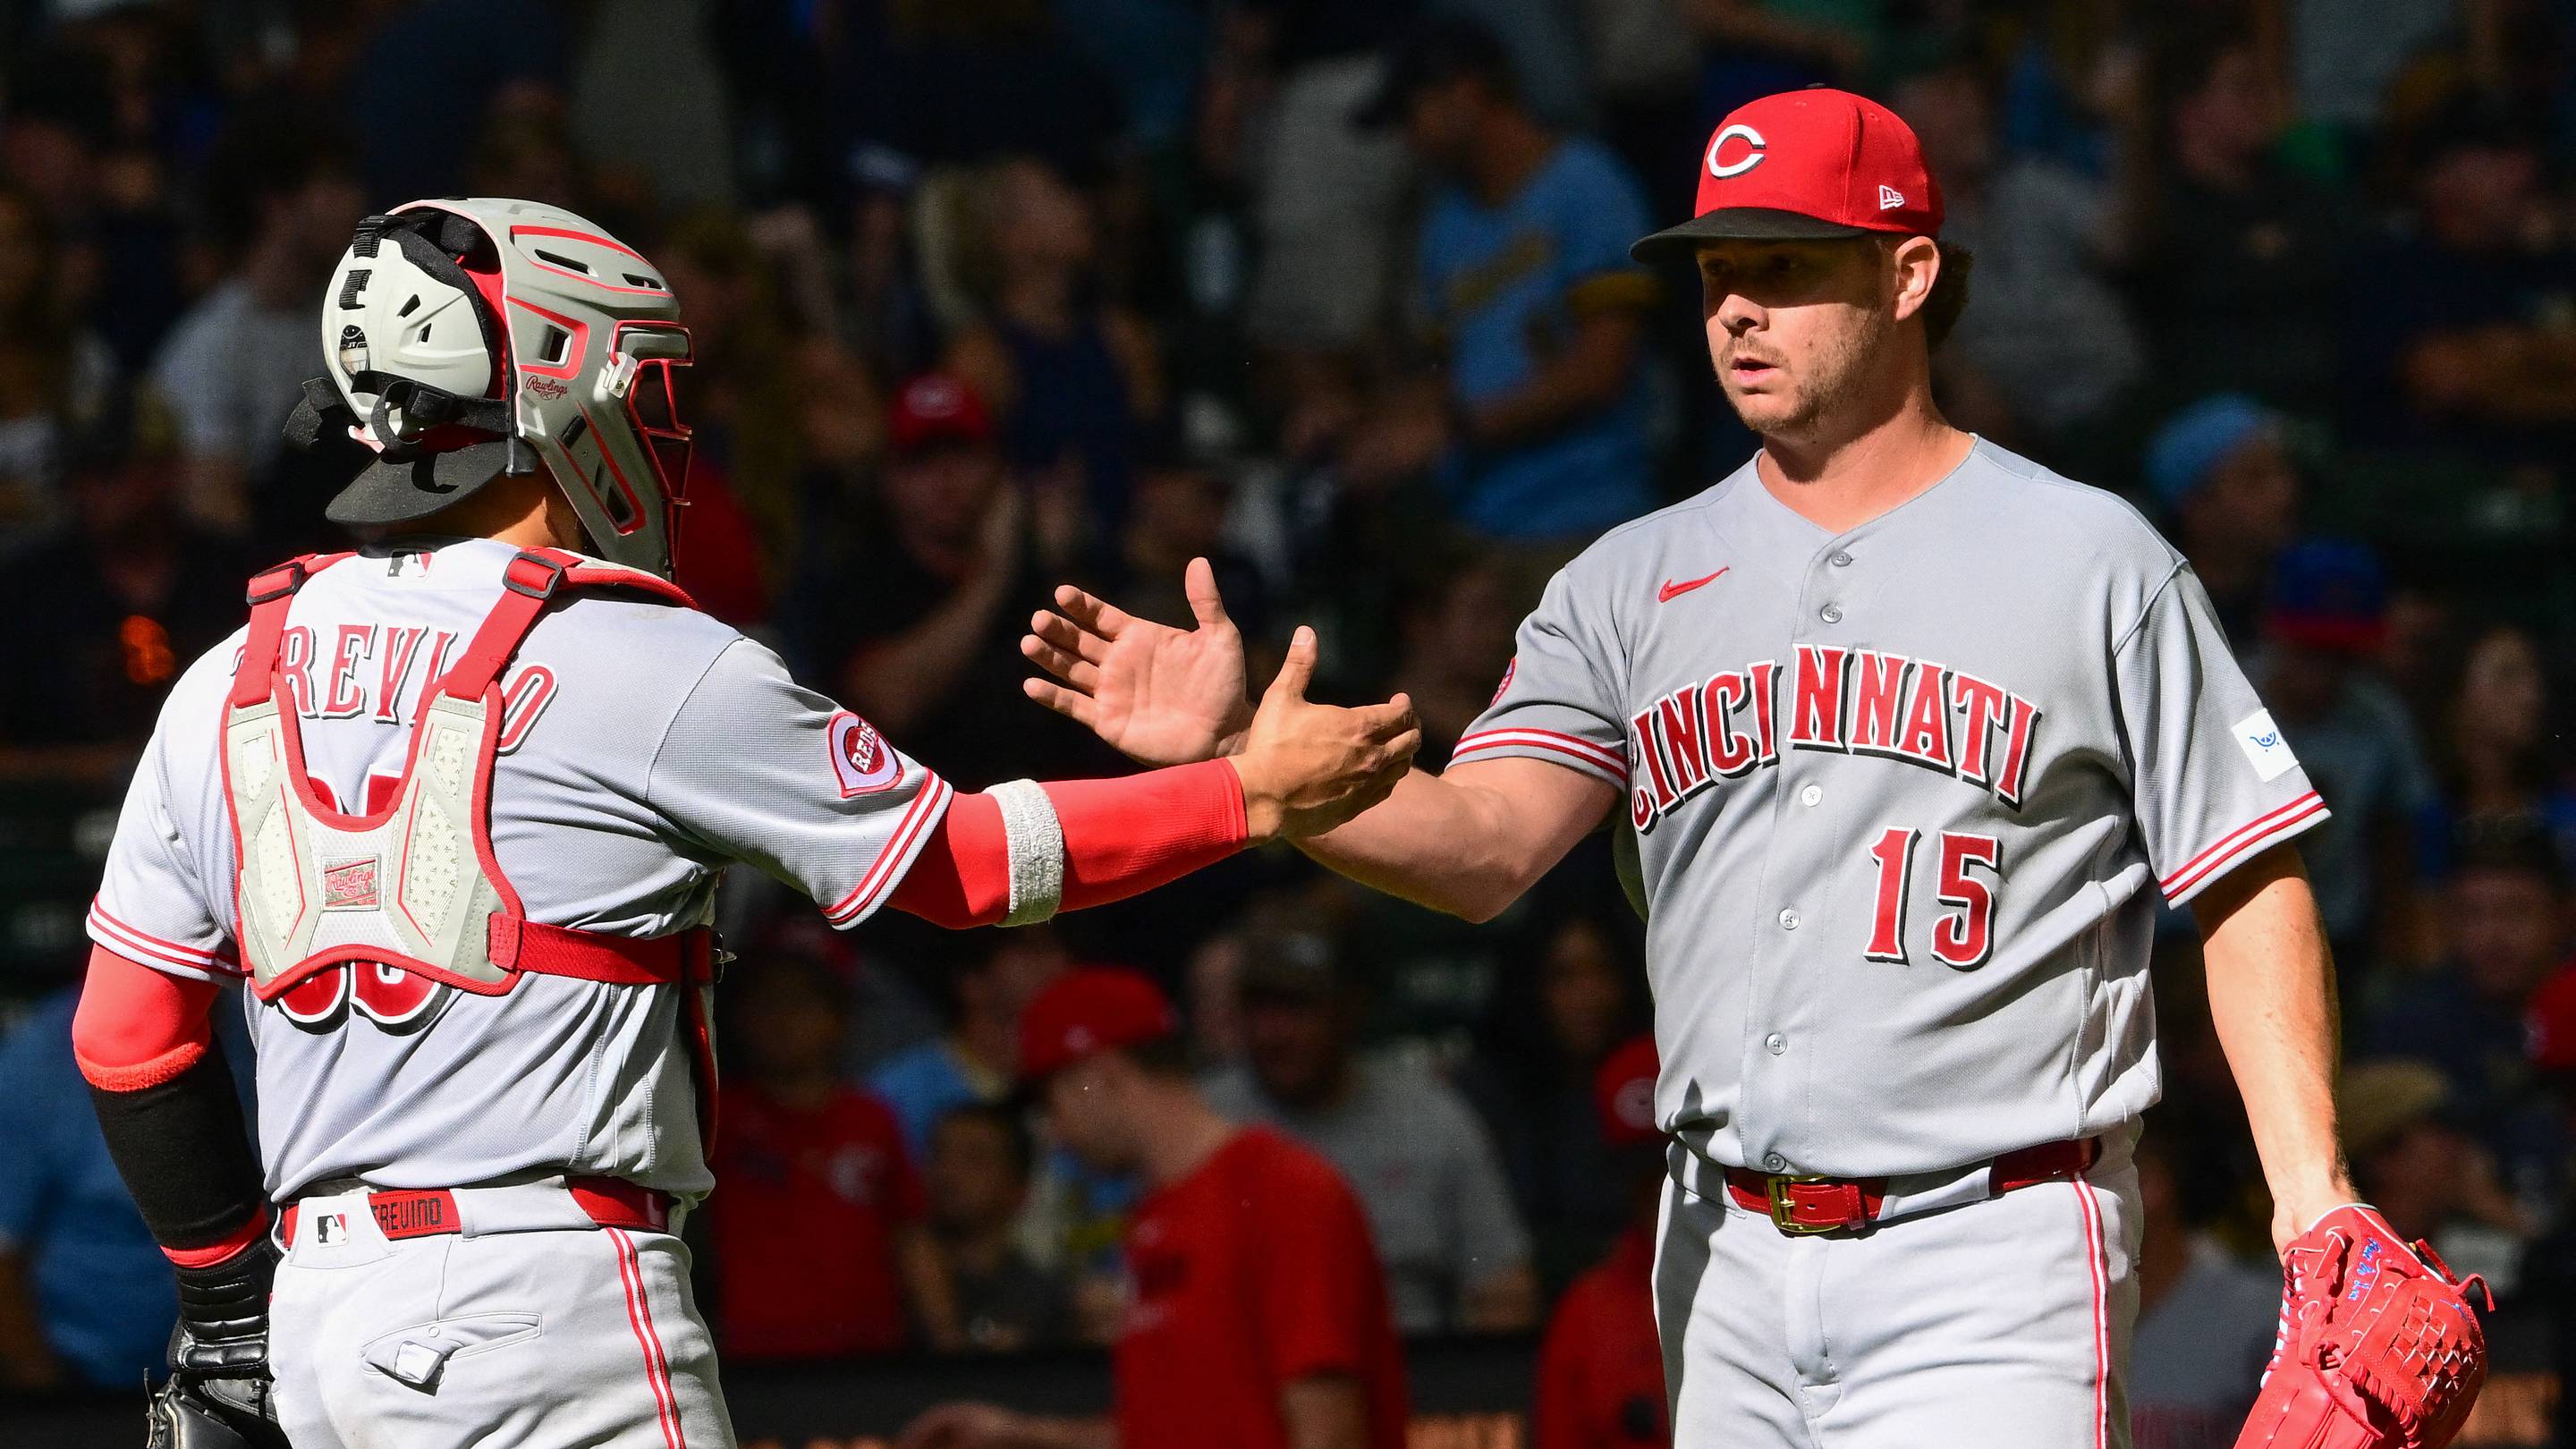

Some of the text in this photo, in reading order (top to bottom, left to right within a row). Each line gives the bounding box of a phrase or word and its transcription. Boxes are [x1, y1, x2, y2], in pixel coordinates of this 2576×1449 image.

[1707, 123, 1767, 179] C
[526, 375, 568, 400] Rawlings
[230, 623, 558, 756] REVIO
[851, 721, 877, 772] REDS
[1863, 826, 2001, 971] 15
